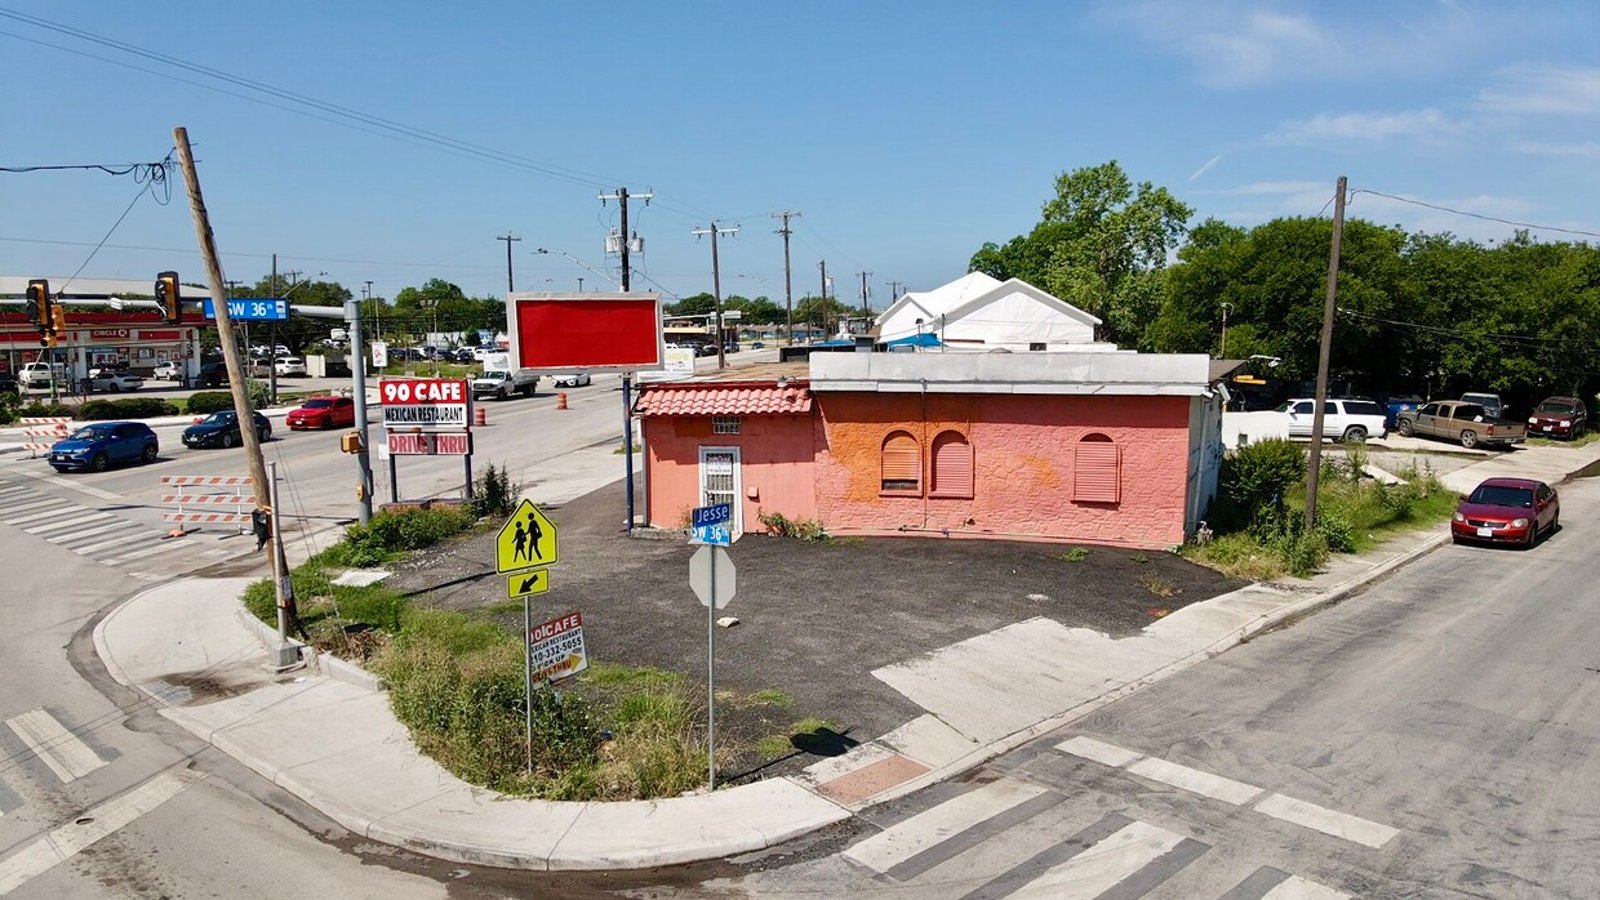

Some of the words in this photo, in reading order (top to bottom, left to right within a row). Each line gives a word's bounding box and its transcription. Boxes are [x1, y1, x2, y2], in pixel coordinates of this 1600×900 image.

[384, 383, 410, 402] 90
[415, 382, 461, 401] CAFE
[385, 407, 417, 422] MEXICAN
[418, 406, 463, 422] RESTAURANT
[388, 435, 427, 453] DRIVE
[697, 505, 728, 523] Jesse
[533, 636, 582, 662] 10-332-5055
